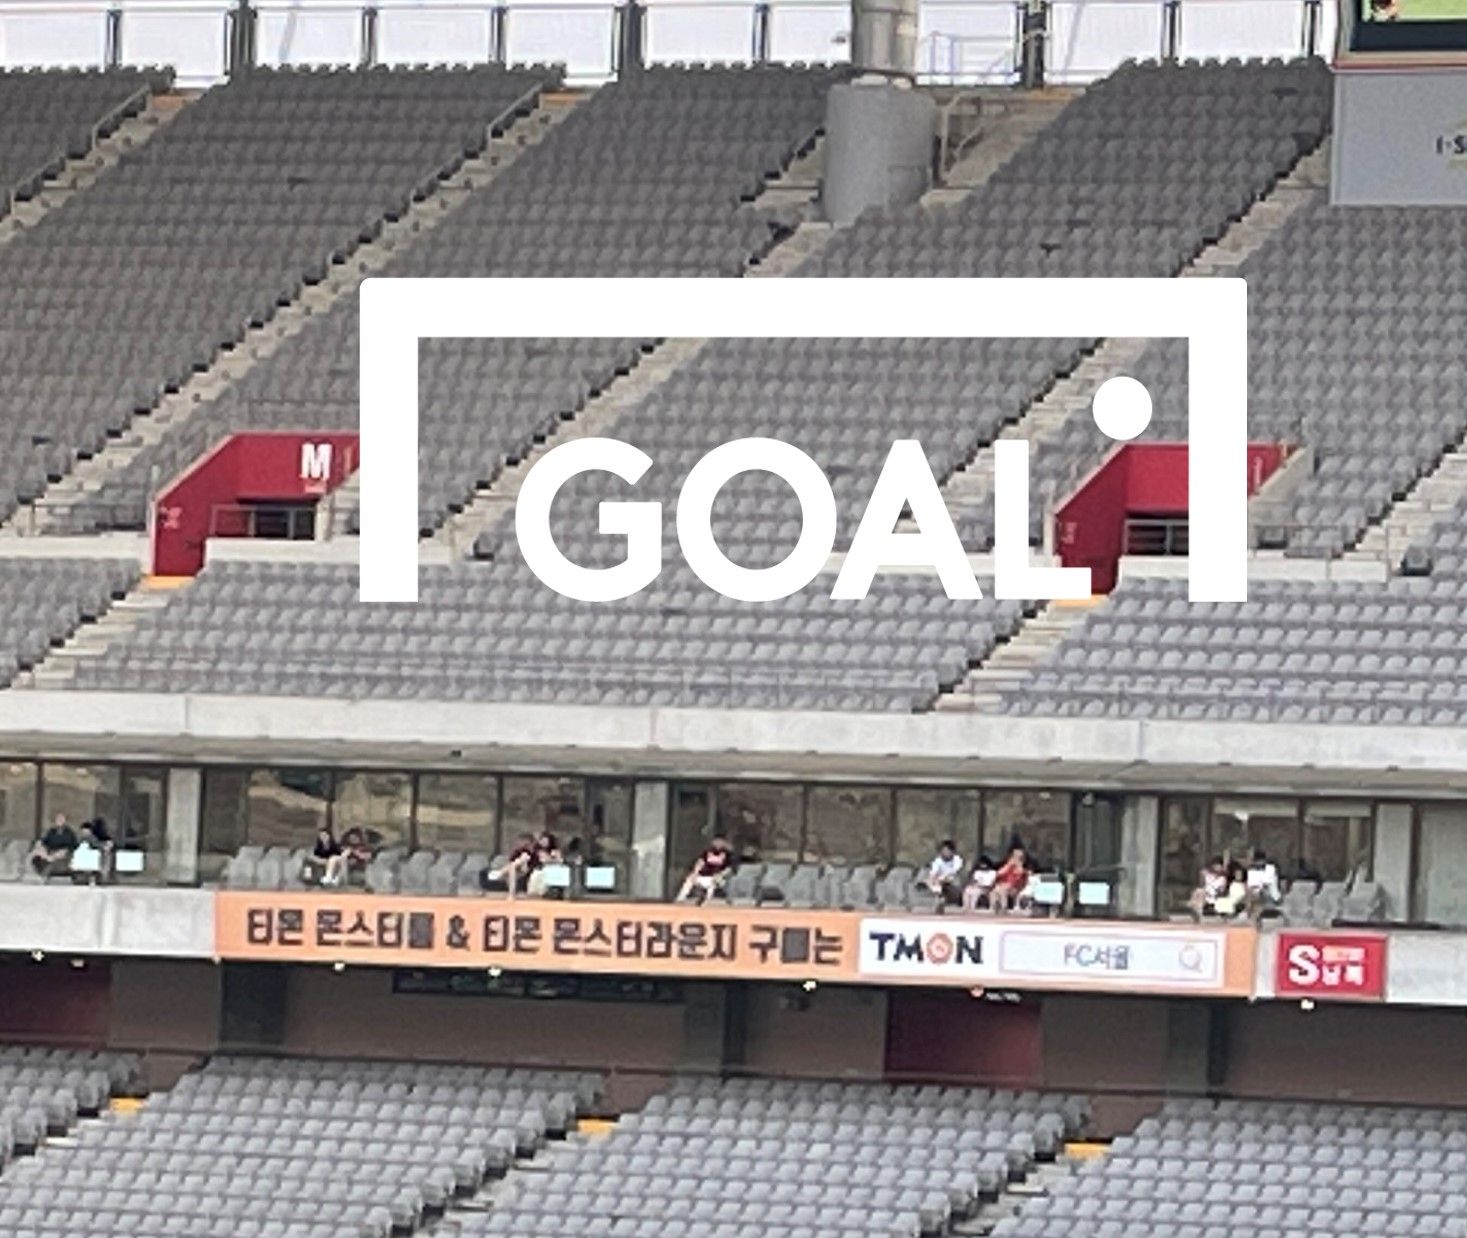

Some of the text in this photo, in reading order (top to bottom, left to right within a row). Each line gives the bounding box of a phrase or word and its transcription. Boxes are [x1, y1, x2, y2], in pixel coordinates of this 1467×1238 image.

[302, 443, 330, 479] M
[316, 909, 435, 949] 몬스터
[446, 914, 470, 949] &
[553, 917, 738, 961] 몬스터라운지
[749, 924, 844, 965] 구는
[868, 931, 984, 964] TMON
[1288, 944, 1320, 985] S
